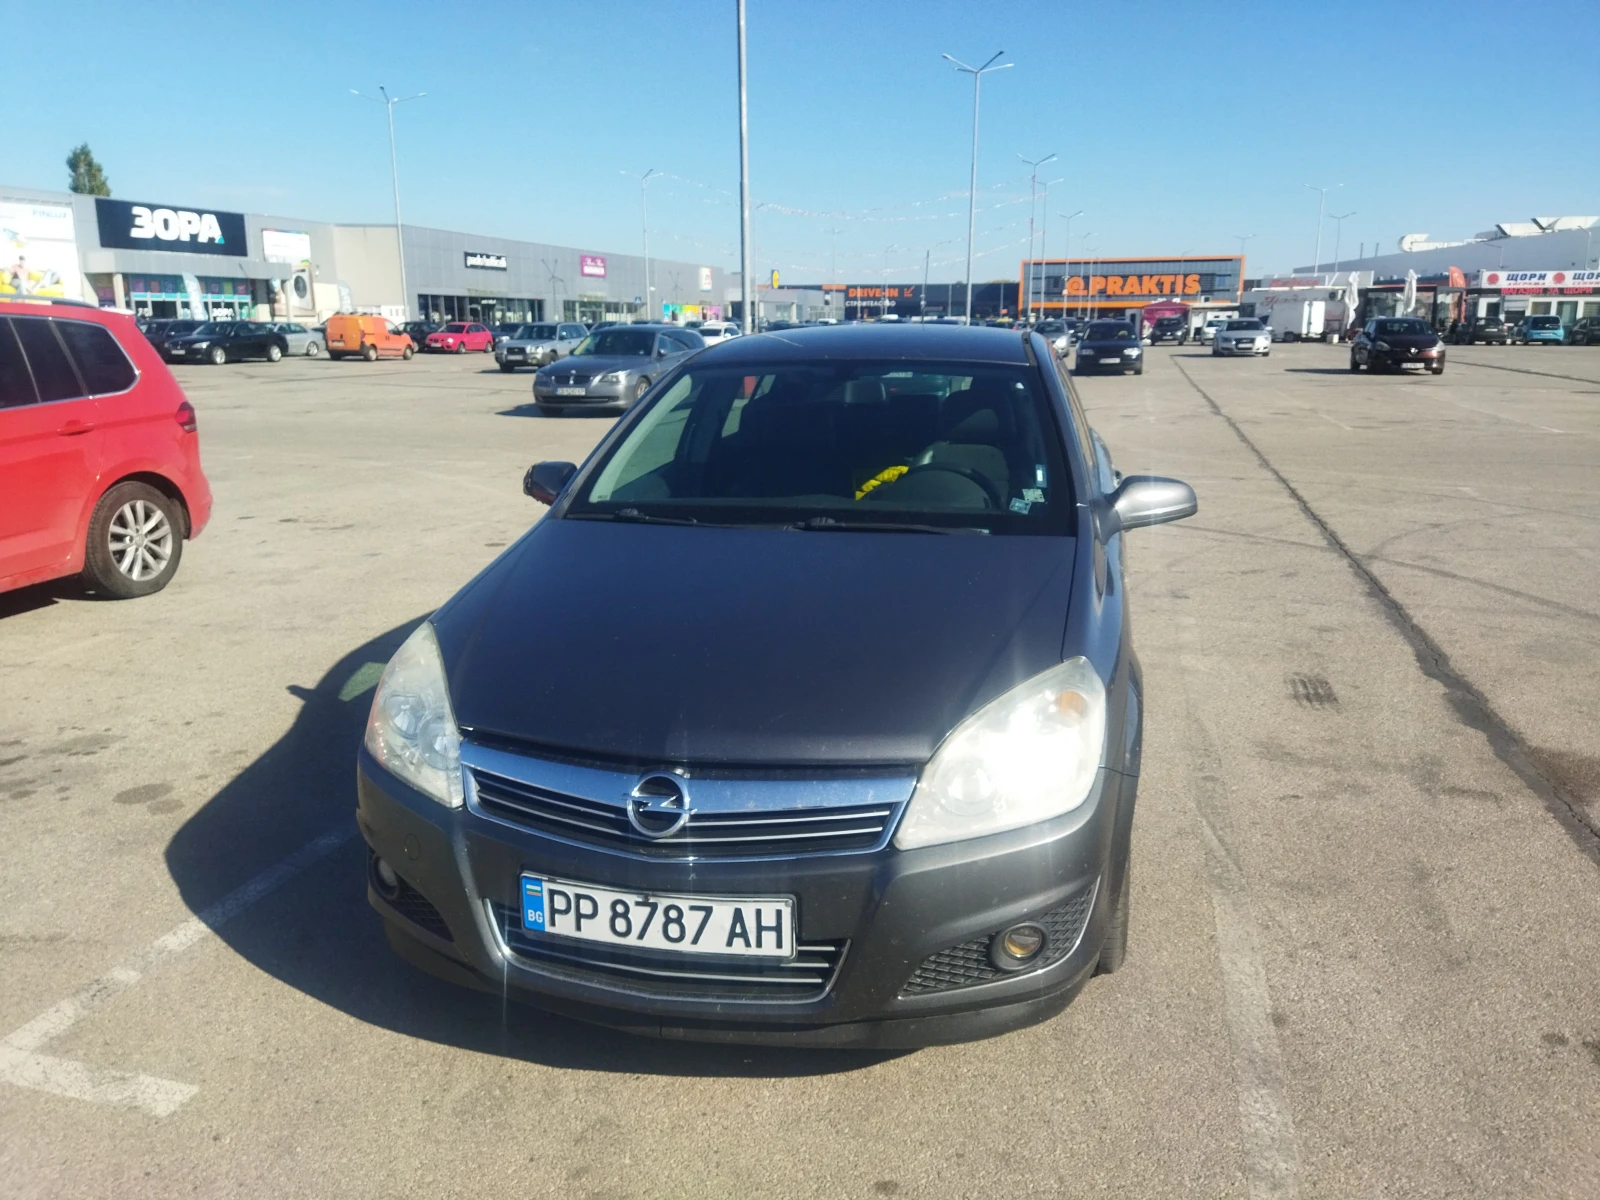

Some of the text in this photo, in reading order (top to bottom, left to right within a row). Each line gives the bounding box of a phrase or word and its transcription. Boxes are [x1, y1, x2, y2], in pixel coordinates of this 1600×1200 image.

[129, 206, 224, 244] ЗОРА
[1091, 274, 1200, 295] PRAKTIS
[1506, 273, 1547, 282] ЩОРИ
[848, 288, 899, 297] DRIVE-IN
[527, 909, 543, 924] BG
[547, 888, 783, 950] PP 8787 AH
